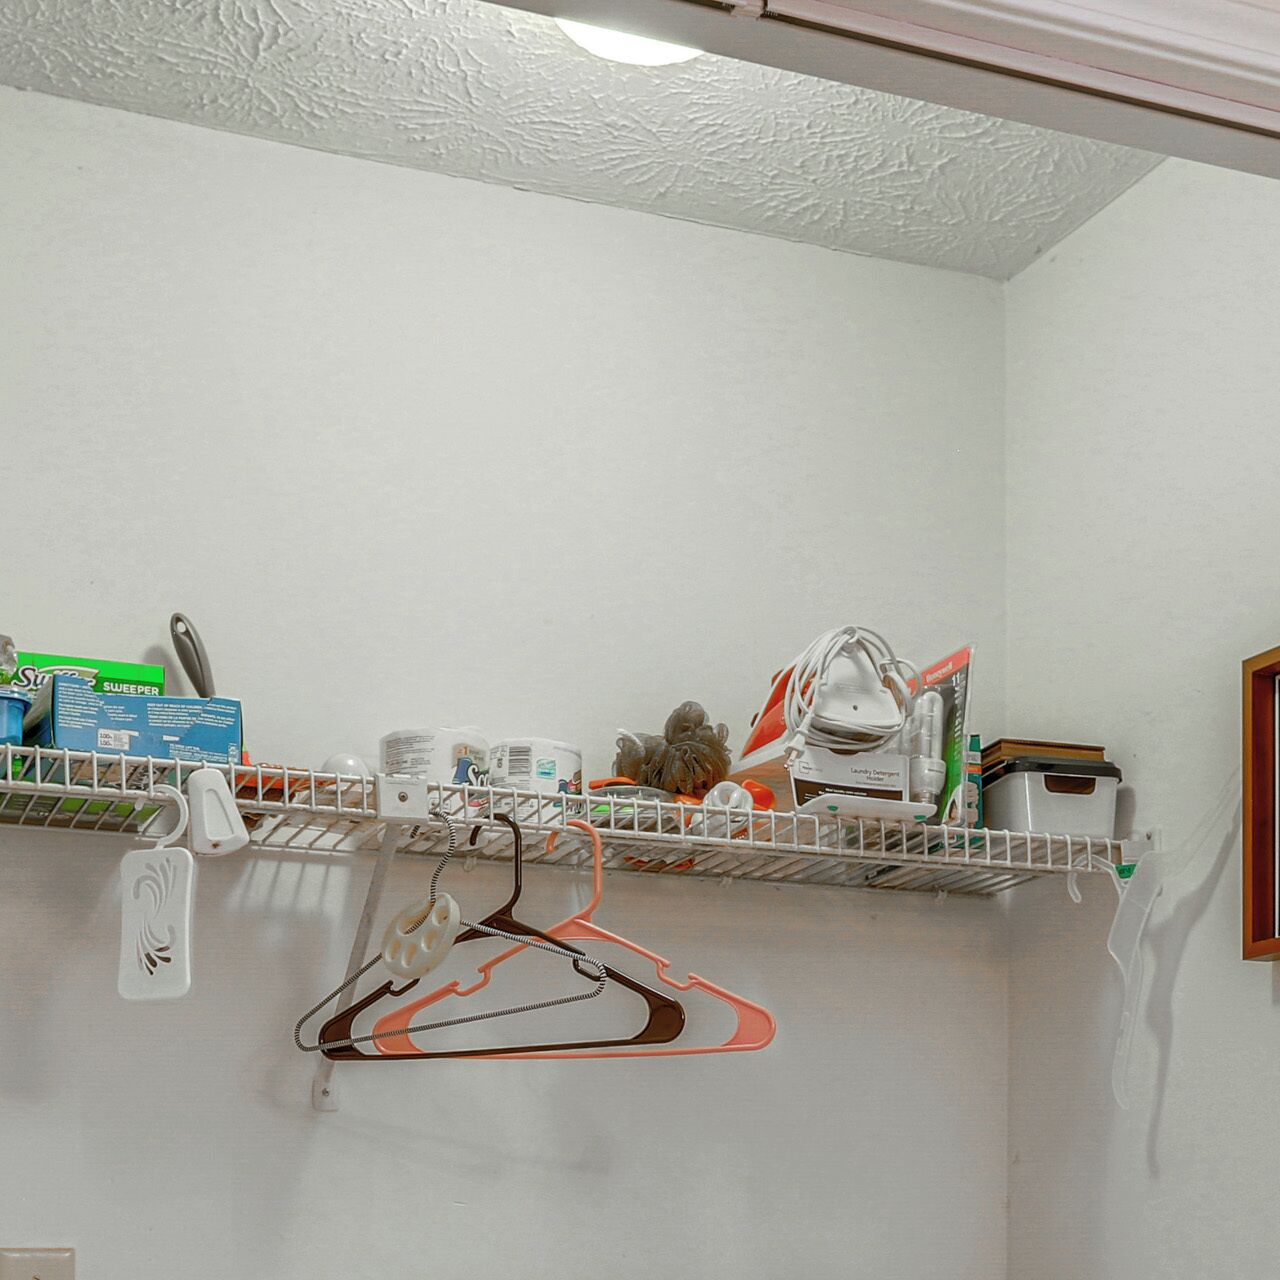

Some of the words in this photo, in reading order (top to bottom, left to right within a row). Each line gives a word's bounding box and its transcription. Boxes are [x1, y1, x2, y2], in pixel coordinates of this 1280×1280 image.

[103, 681, 160, 696] SWEEPER
[850, 767, 872, 776] Laundry
[872, 769, 900, 778] Detergent
